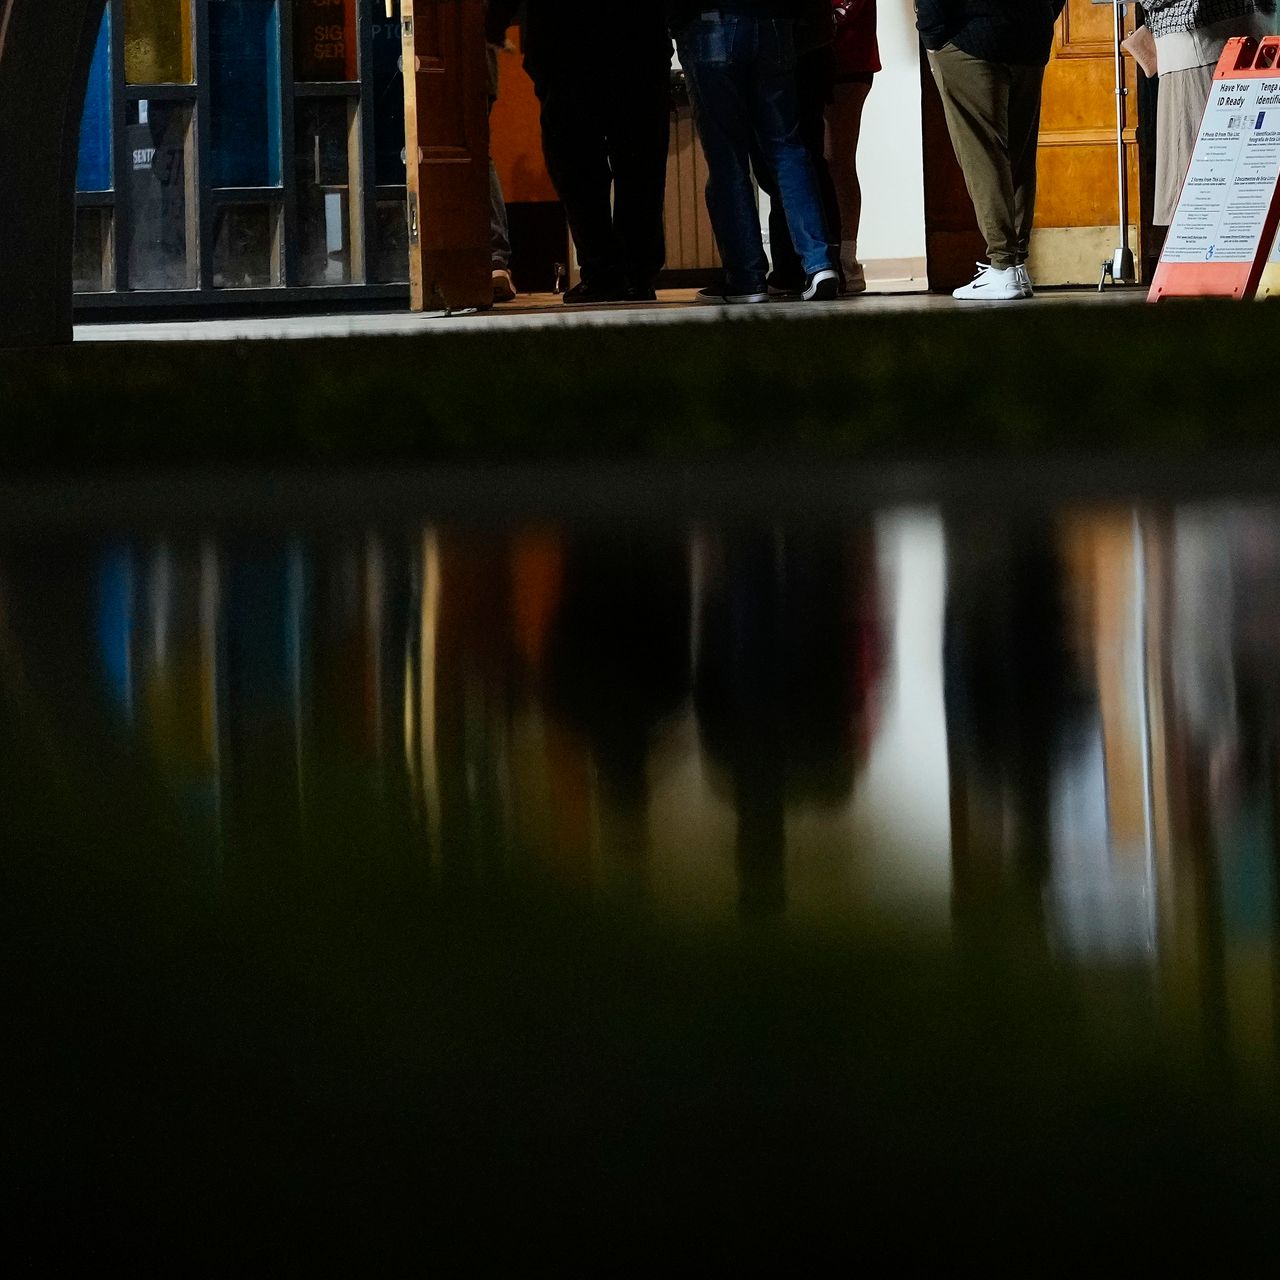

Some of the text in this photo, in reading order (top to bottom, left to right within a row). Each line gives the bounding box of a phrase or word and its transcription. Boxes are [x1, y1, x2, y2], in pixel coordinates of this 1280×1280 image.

[313, 24, 344, 41] SIG
[1220, 83, 1250, 92] Have Your
[1261, 82, 1277, 93] Tenga
[1217, 96, 1245, 108] ID Ready
